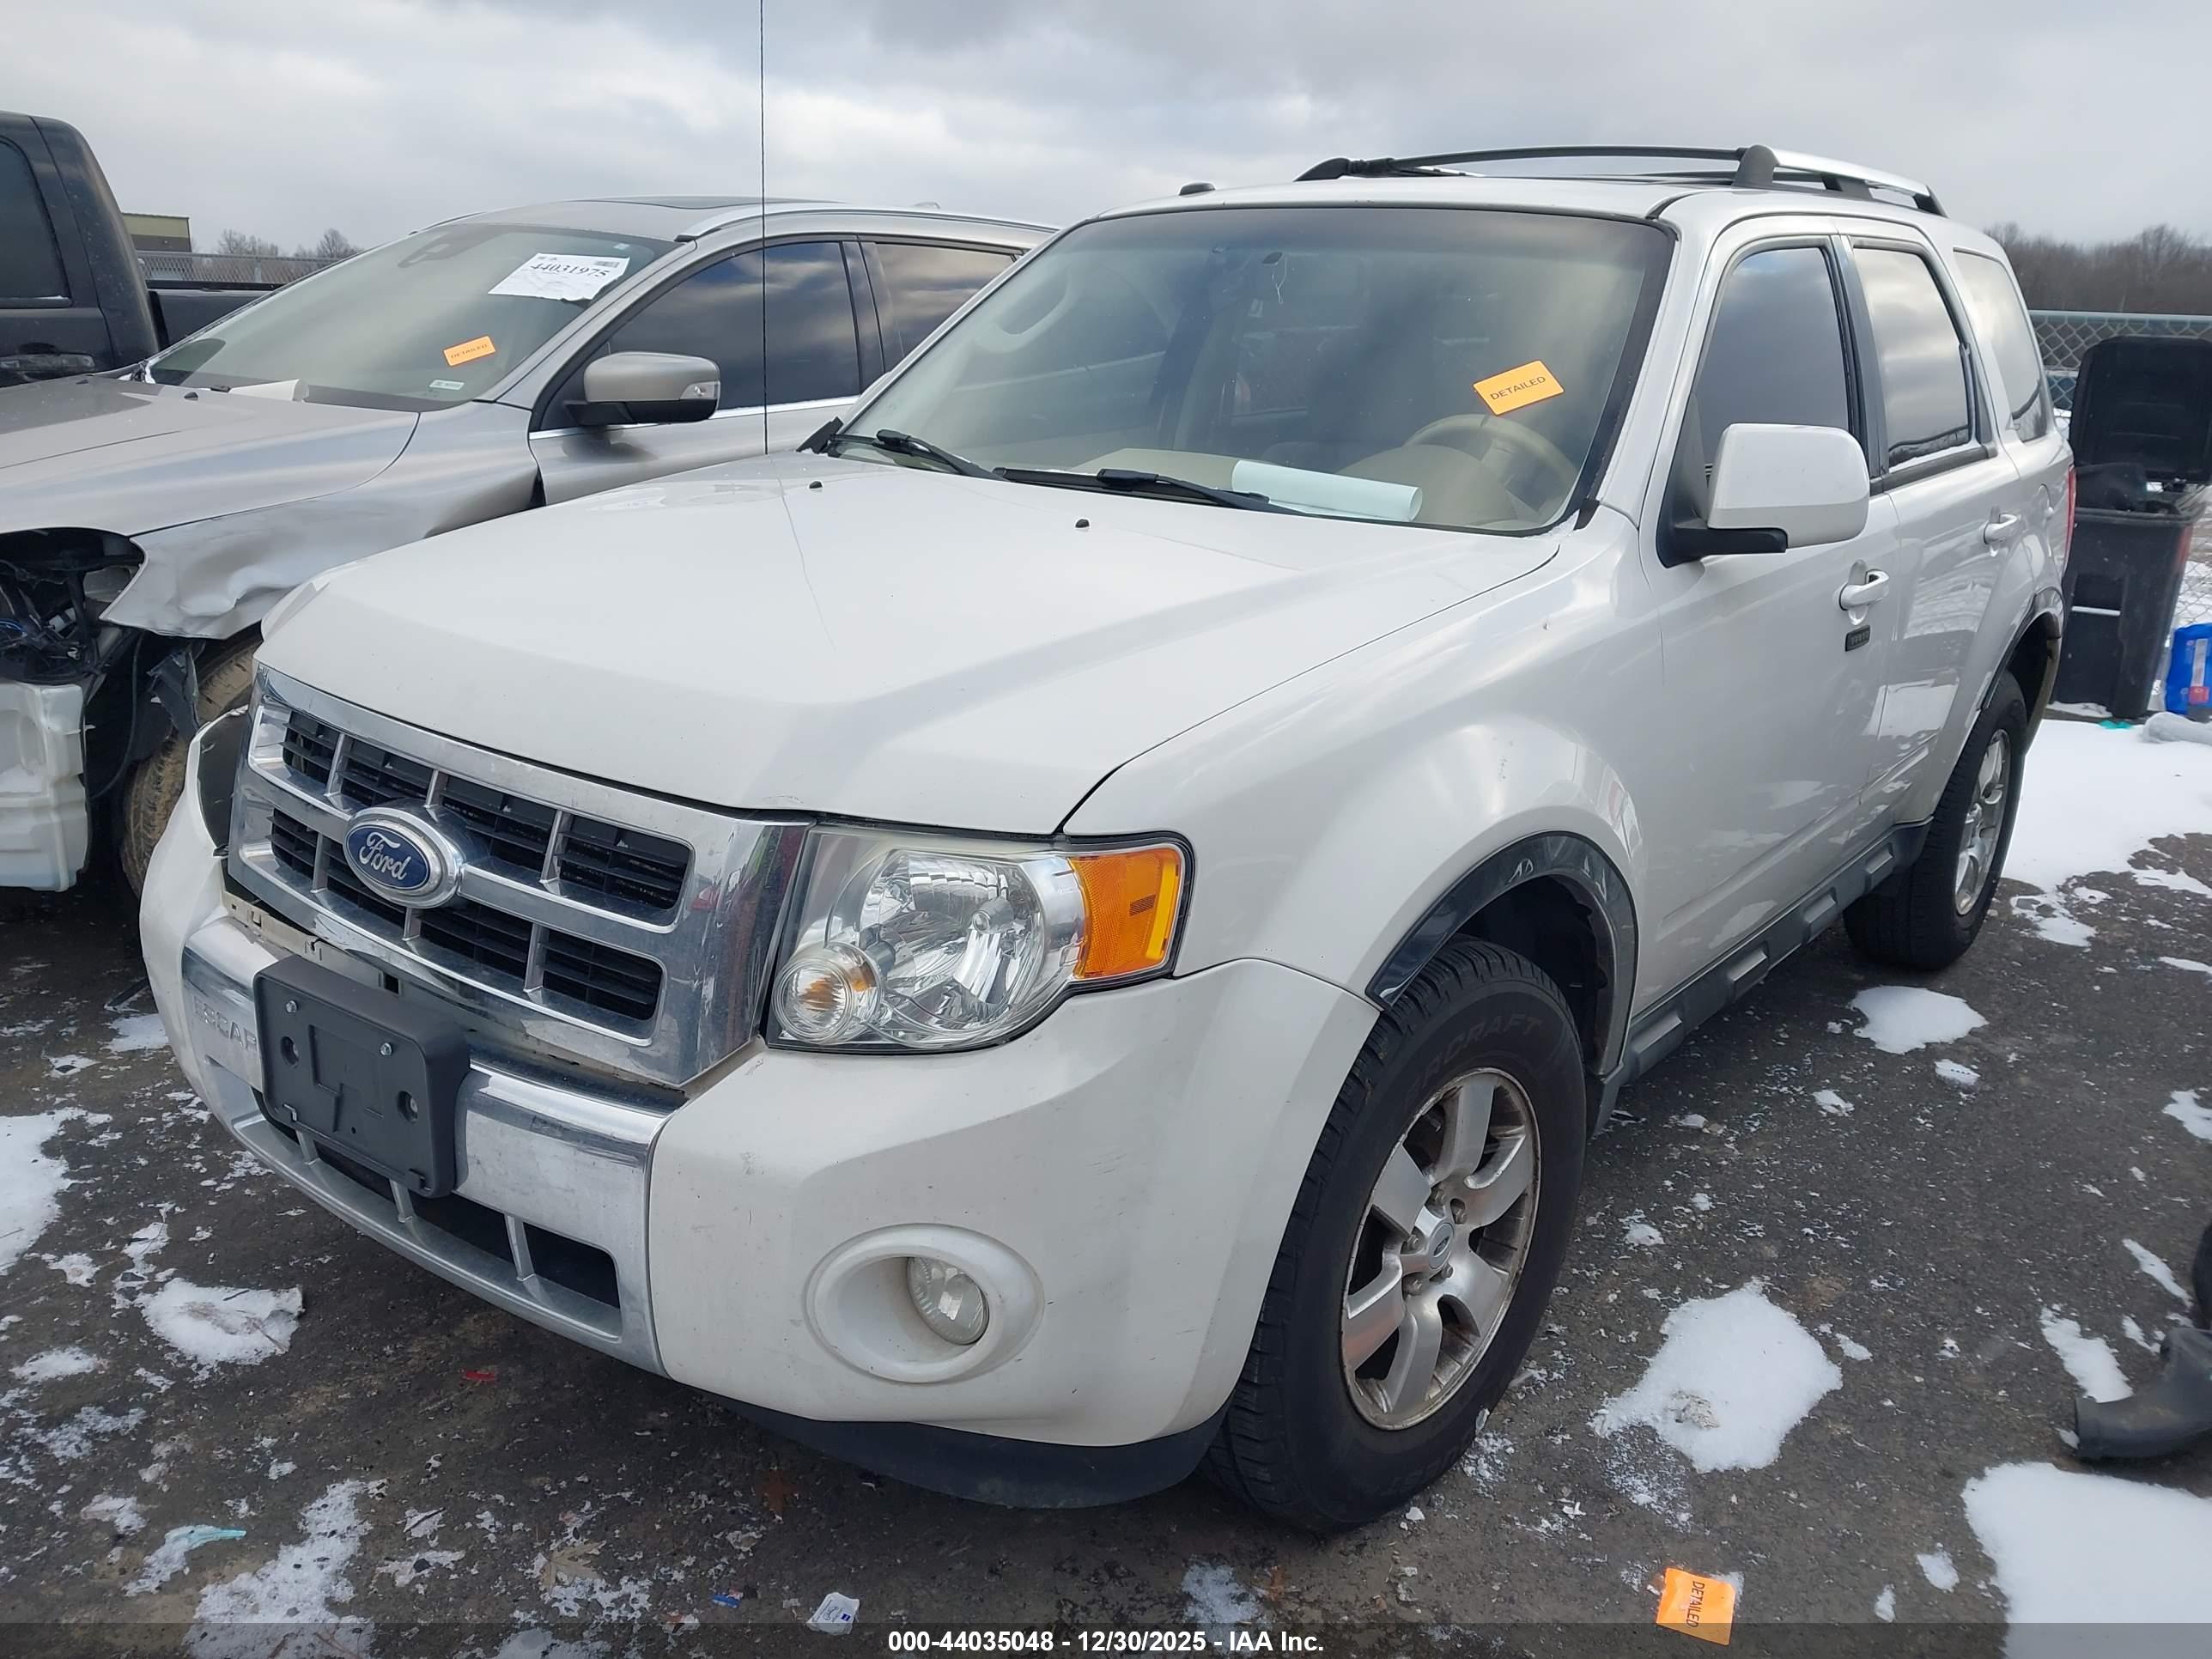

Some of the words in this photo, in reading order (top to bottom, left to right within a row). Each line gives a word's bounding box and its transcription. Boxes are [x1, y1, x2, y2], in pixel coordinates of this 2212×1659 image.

[531, 263, 611, 277] 44031975
[1490, 376, 1547, 400] DETAILED
[359, 832, 411, 880] Ford
[192, 995, 257, 1050] ESCAP
[1686, 1581, 1705, 1627] DETAILED
